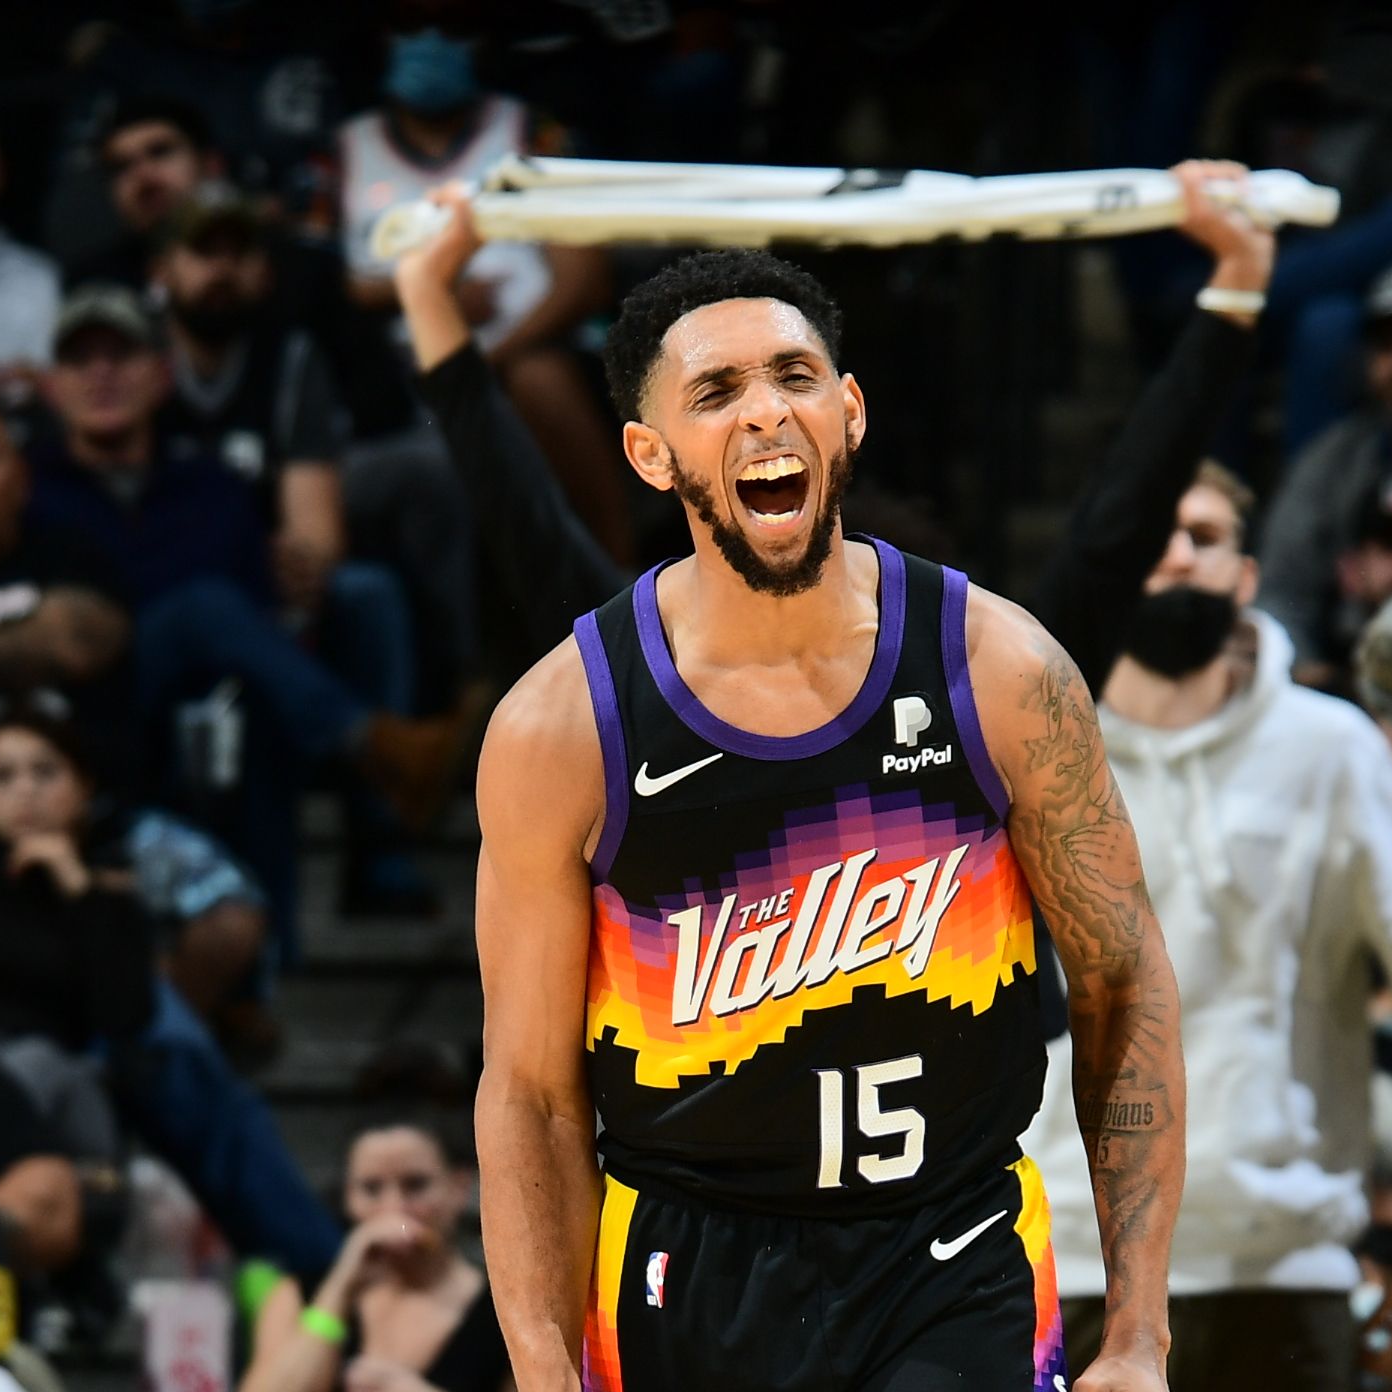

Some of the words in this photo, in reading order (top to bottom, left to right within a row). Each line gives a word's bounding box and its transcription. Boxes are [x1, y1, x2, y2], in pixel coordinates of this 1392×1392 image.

[882, 744, 952, 774] PayPal
[668, 843, 970, 1028] Valley
[739, 888, 795, 930] THE
[813, 1054, 926, 1188] 15
